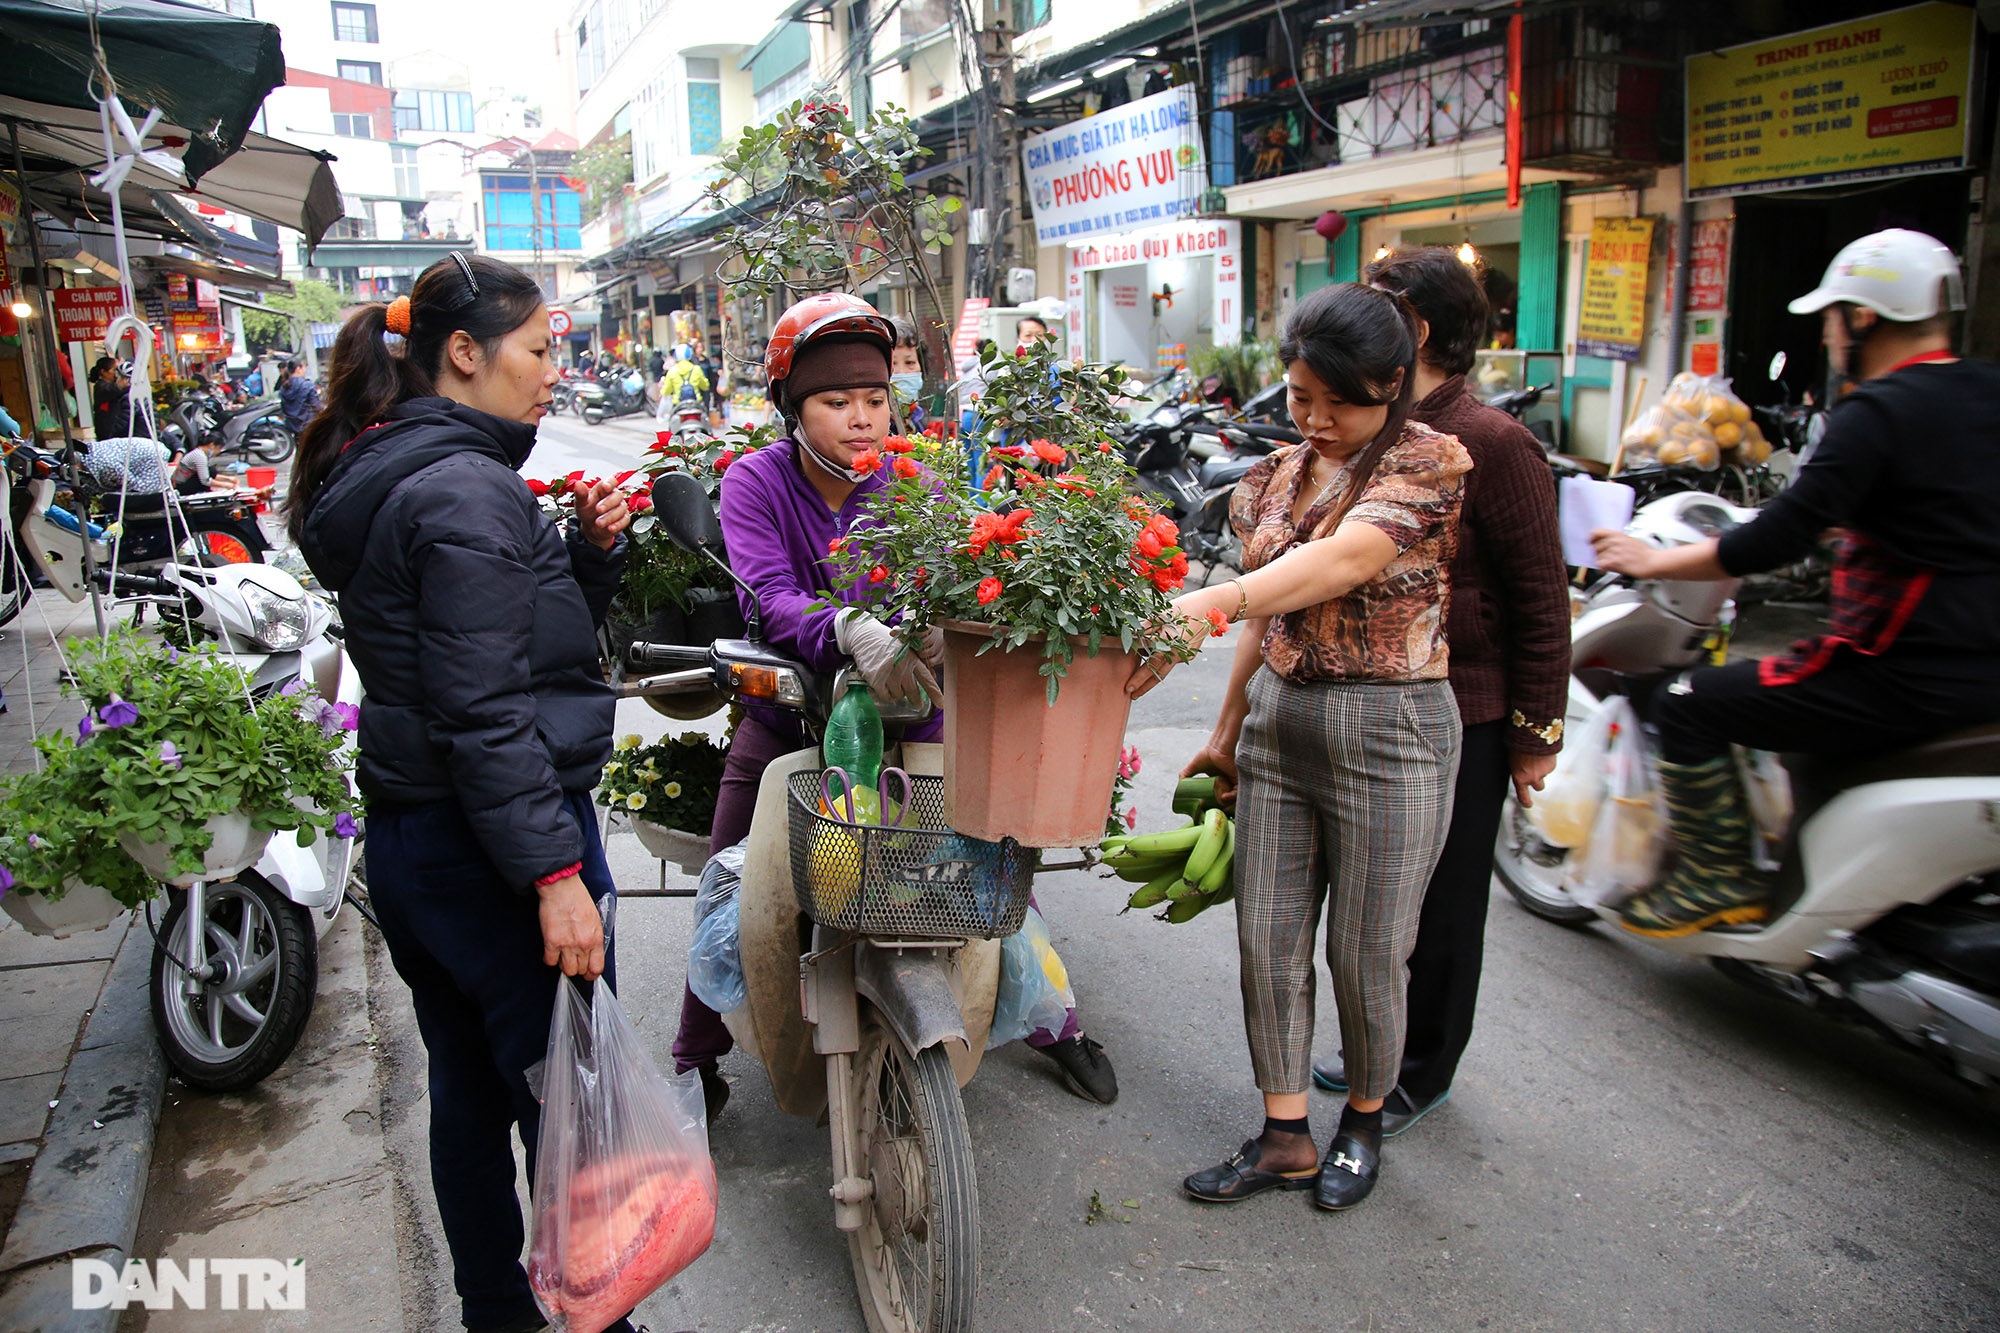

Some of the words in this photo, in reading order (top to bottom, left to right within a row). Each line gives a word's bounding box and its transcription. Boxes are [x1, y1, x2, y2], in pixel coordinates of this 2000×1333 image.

[1814, 28, 1881, 55] THANH
[1028, 136, 1052, 170] CHẢ
[1053, 132, 1080, 164] MỰC
[1104, 119, 1126, 147] TAY
[1130, 112, 1150, 142] HẠ
[1151, 100, 1189, 134] LONG
[1137, 148, 1175, 187] VUI
[1221, 255, 1233, 267] 5
[1070, 274, 1079, 285] 5
[71, 289, 92, 304] CHẢ
[94, 290, 118, 305] MỰC
[58, 306, 92, 323] THOAN
[69, 327, 91, 341] THỊT
